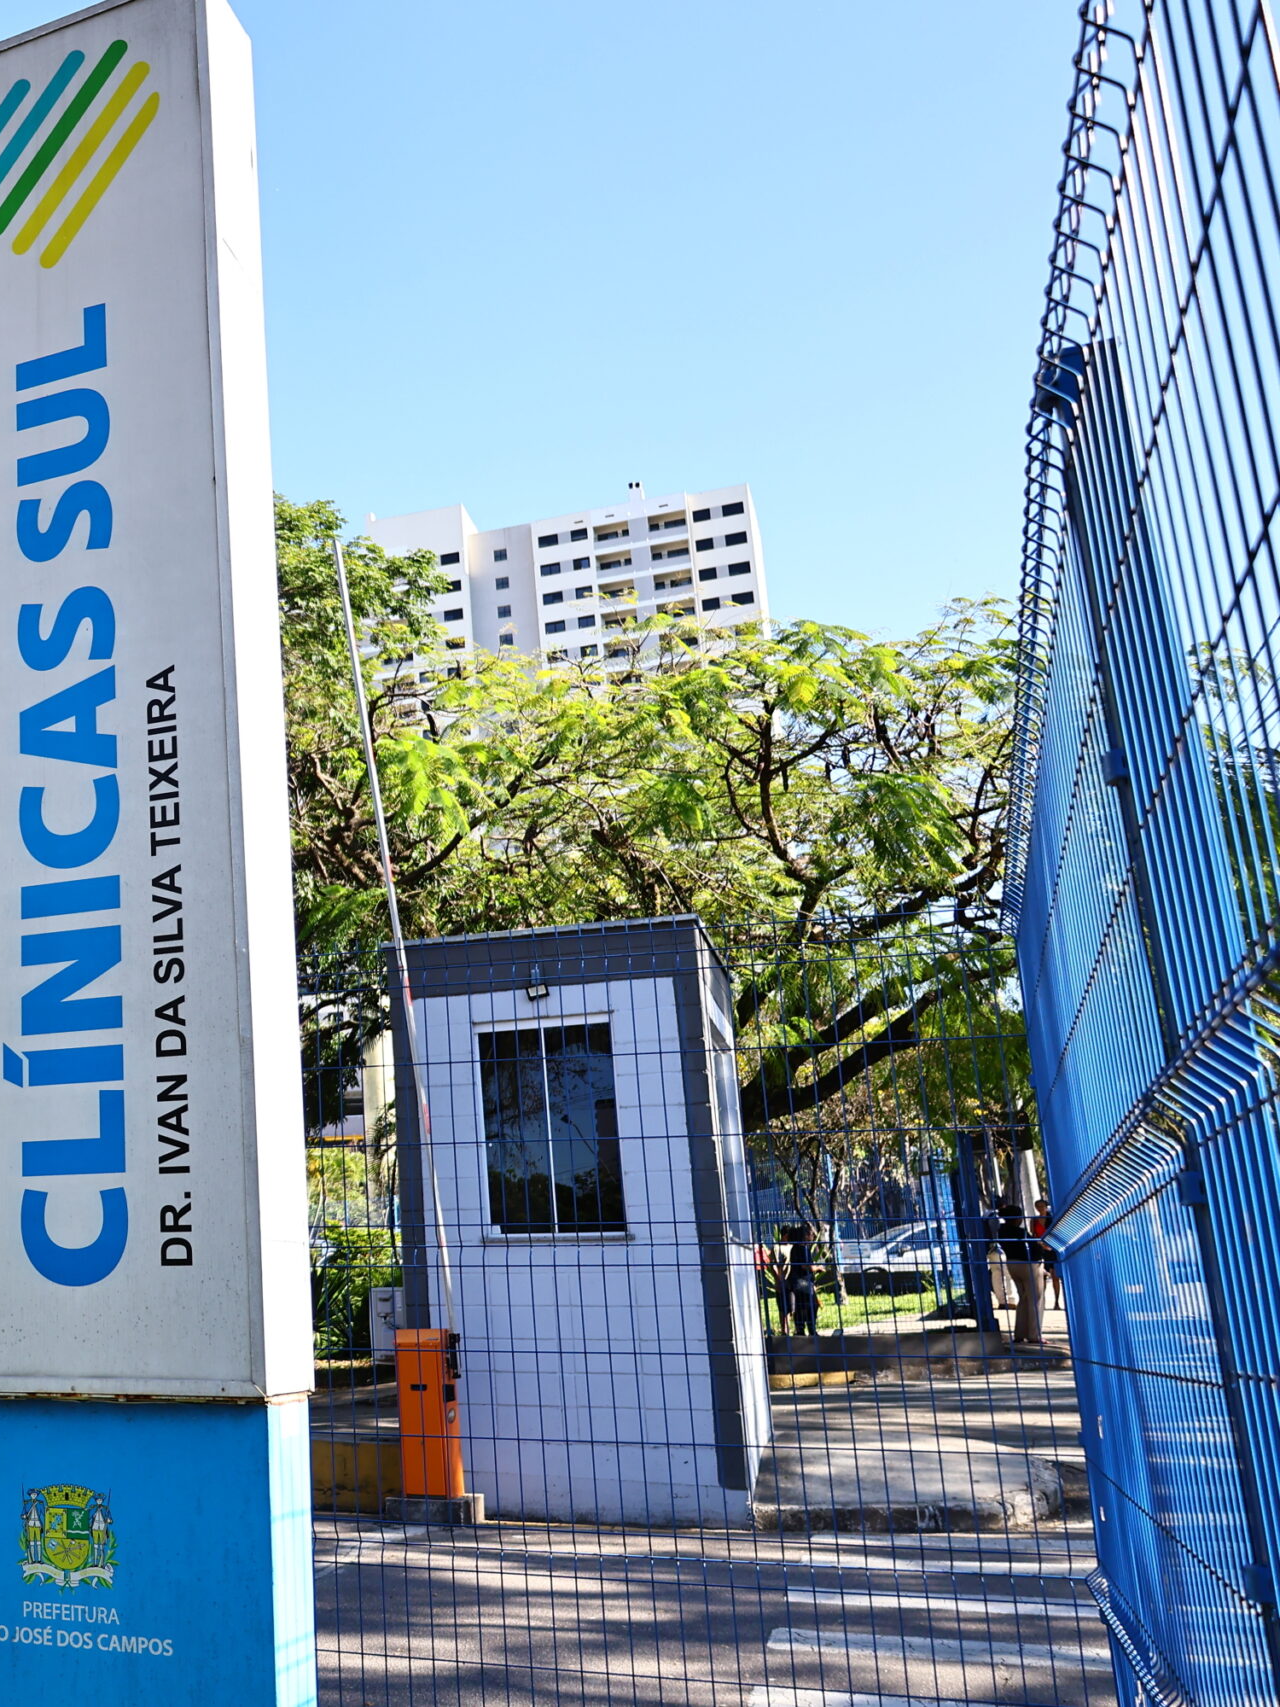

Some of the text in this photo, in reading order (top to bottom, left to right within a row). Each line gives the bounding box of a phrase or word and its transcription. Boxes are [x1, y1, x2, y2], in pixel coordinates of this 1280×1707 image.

[3, 303, 129, 1287] CLÍNICAS SUL
[145, 664, 193, 1267] DR. IVAN DA SILVA TEIXEIRA
[12, 1626, 53, 1646] JOSÉ
[57, 1630, 93, 1649] DOS
[97, 1634, 173, 1657] CAMPOS
[23, 1600, 120, 1625] PREFEITURA
